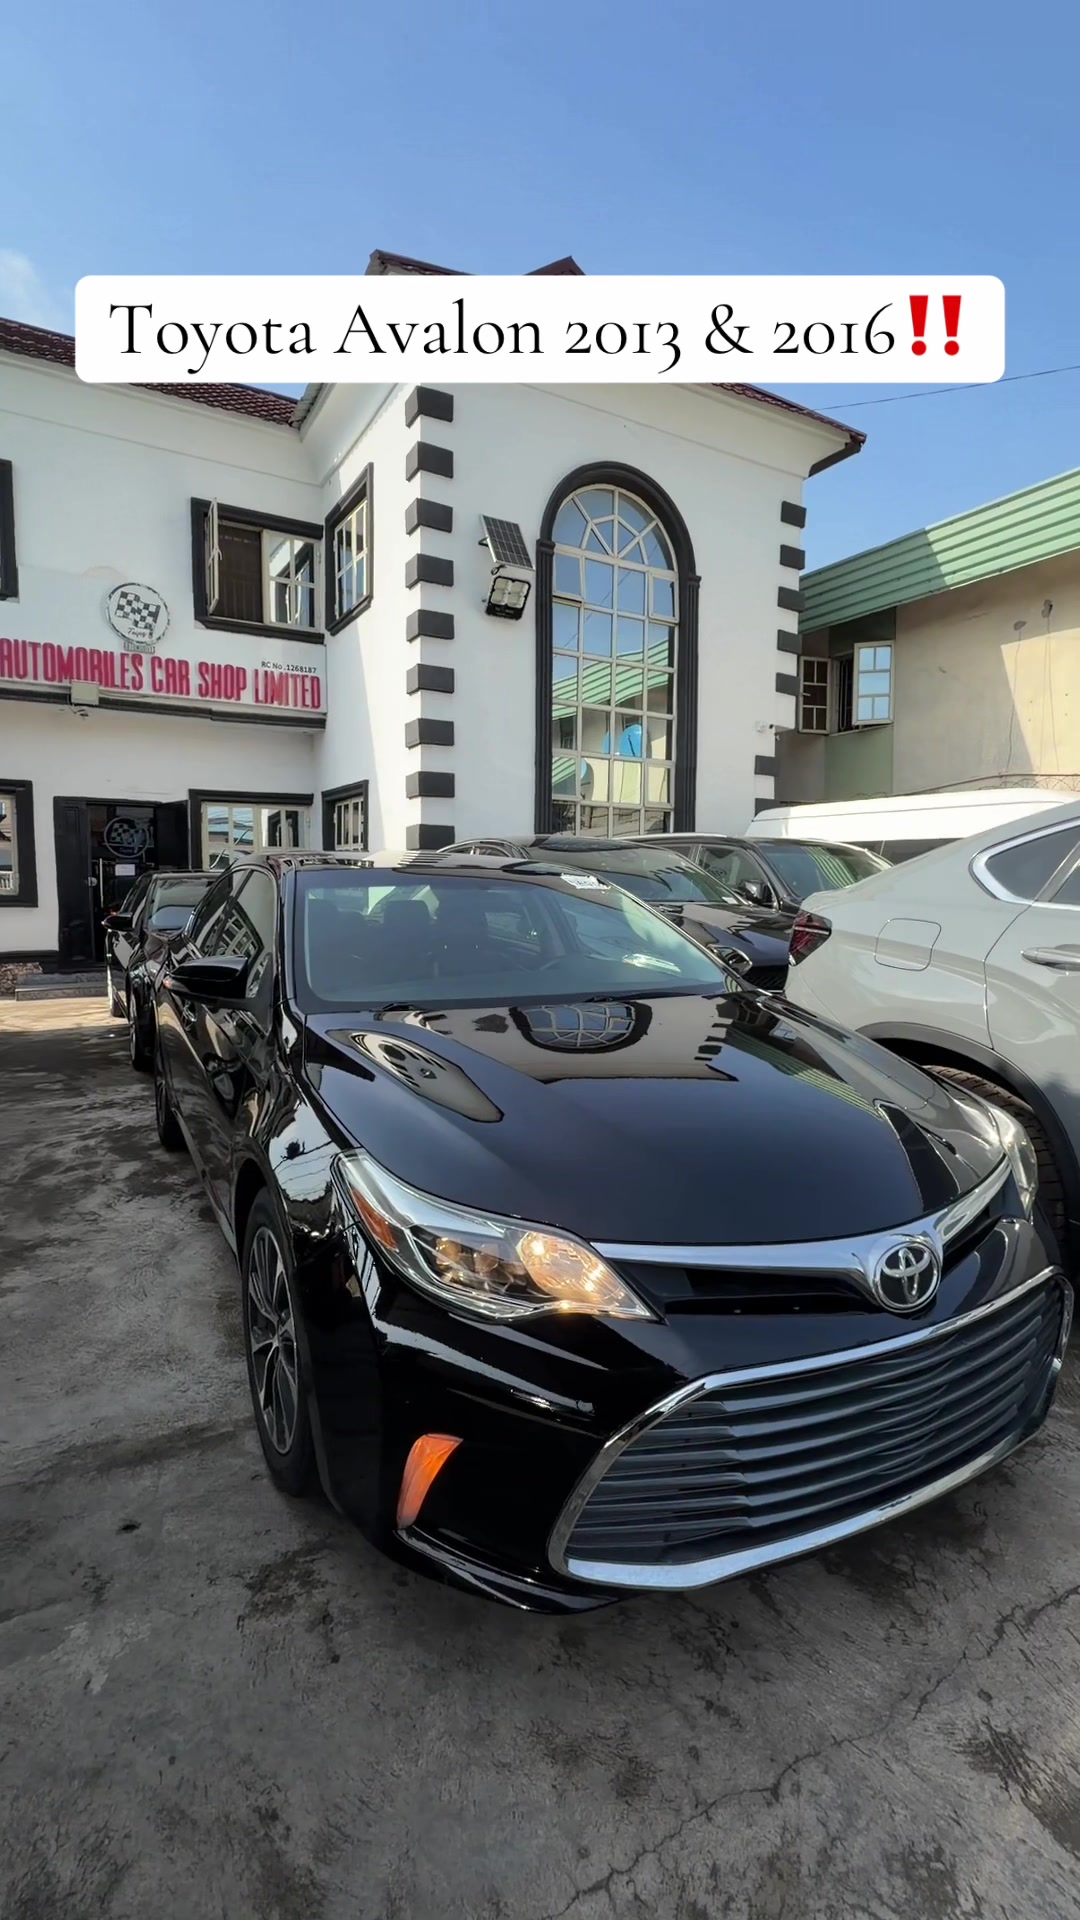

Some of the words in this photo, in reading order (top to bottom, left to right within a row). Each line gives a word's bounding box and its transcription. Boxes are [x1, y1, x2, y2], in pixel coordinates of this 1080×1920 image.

[0, 637, 144, 691] AUTOMOBILES
[150, 656, 190, 696] CAR
[198, 661, 247, 701] SHOP
[254, 669, 321, 709] LIMITED
